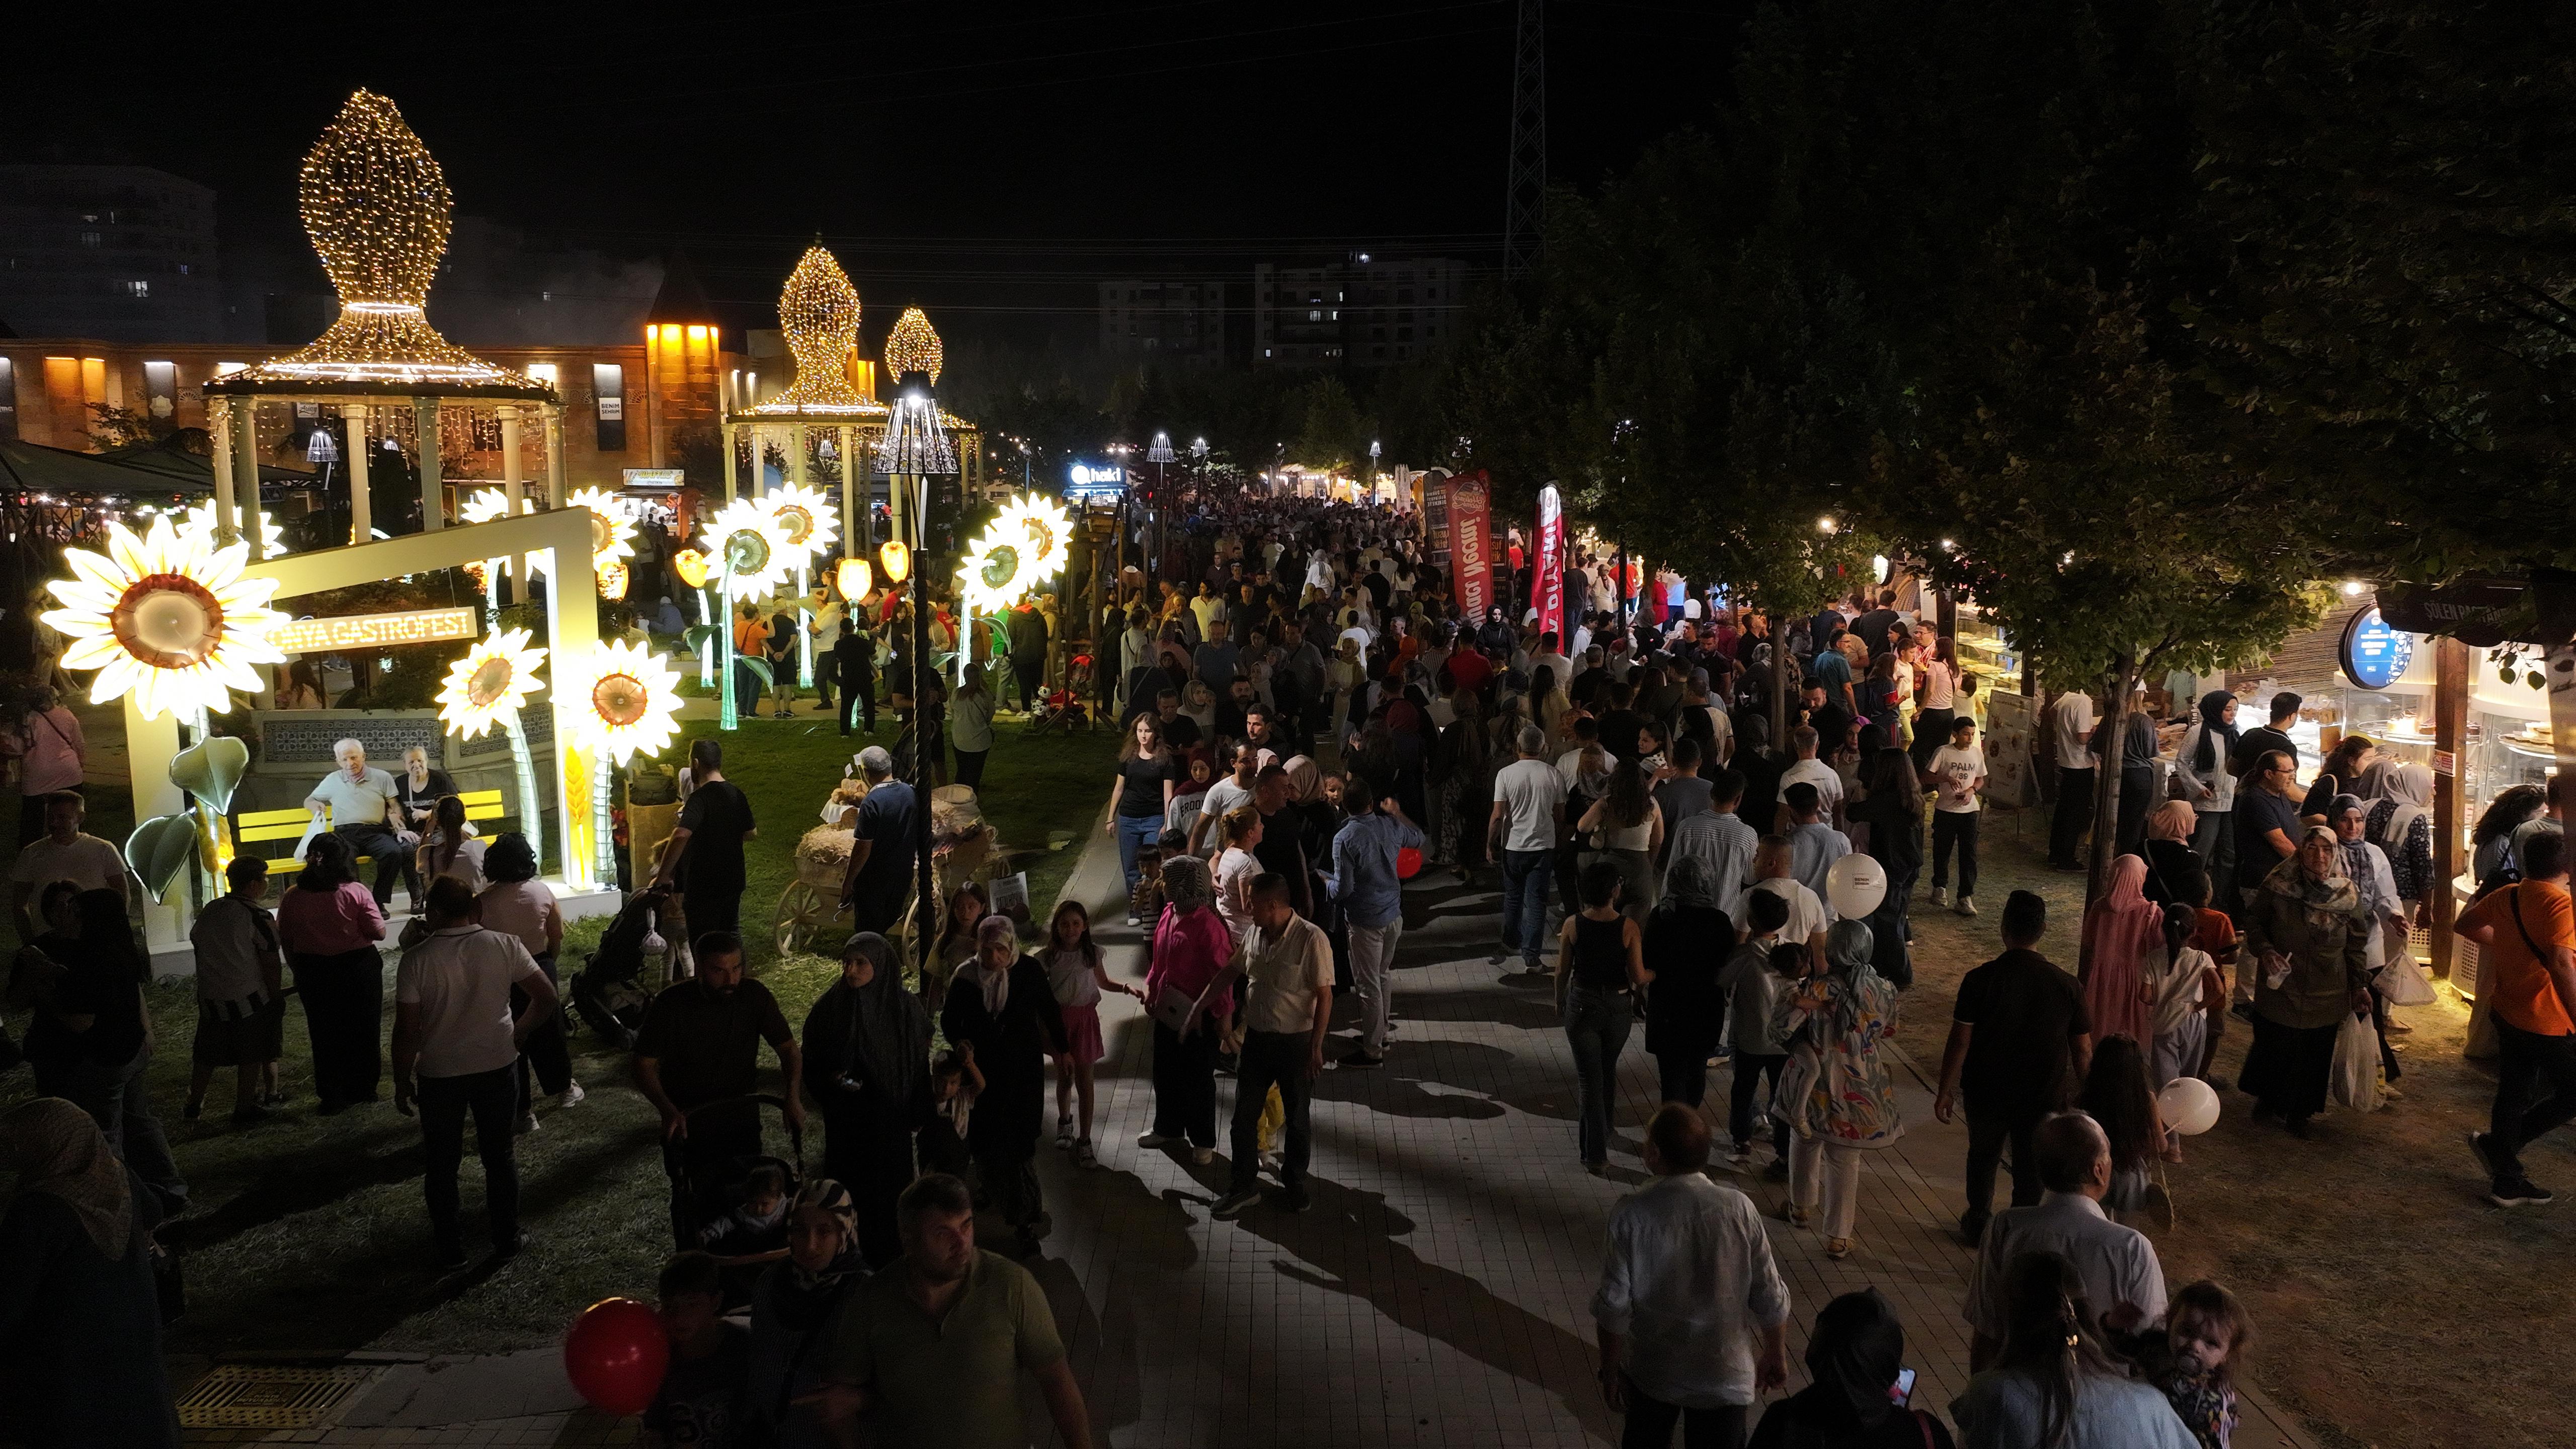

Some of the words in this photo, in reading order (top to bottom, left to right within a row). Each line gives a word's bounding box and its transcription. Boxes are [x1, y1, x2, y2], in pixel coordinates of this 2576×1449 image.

[269, 623, 332, 650] ONYA
[333, 611, 468, 645] GASTROFEST
[1951, 762, 1976, 771] PALM
